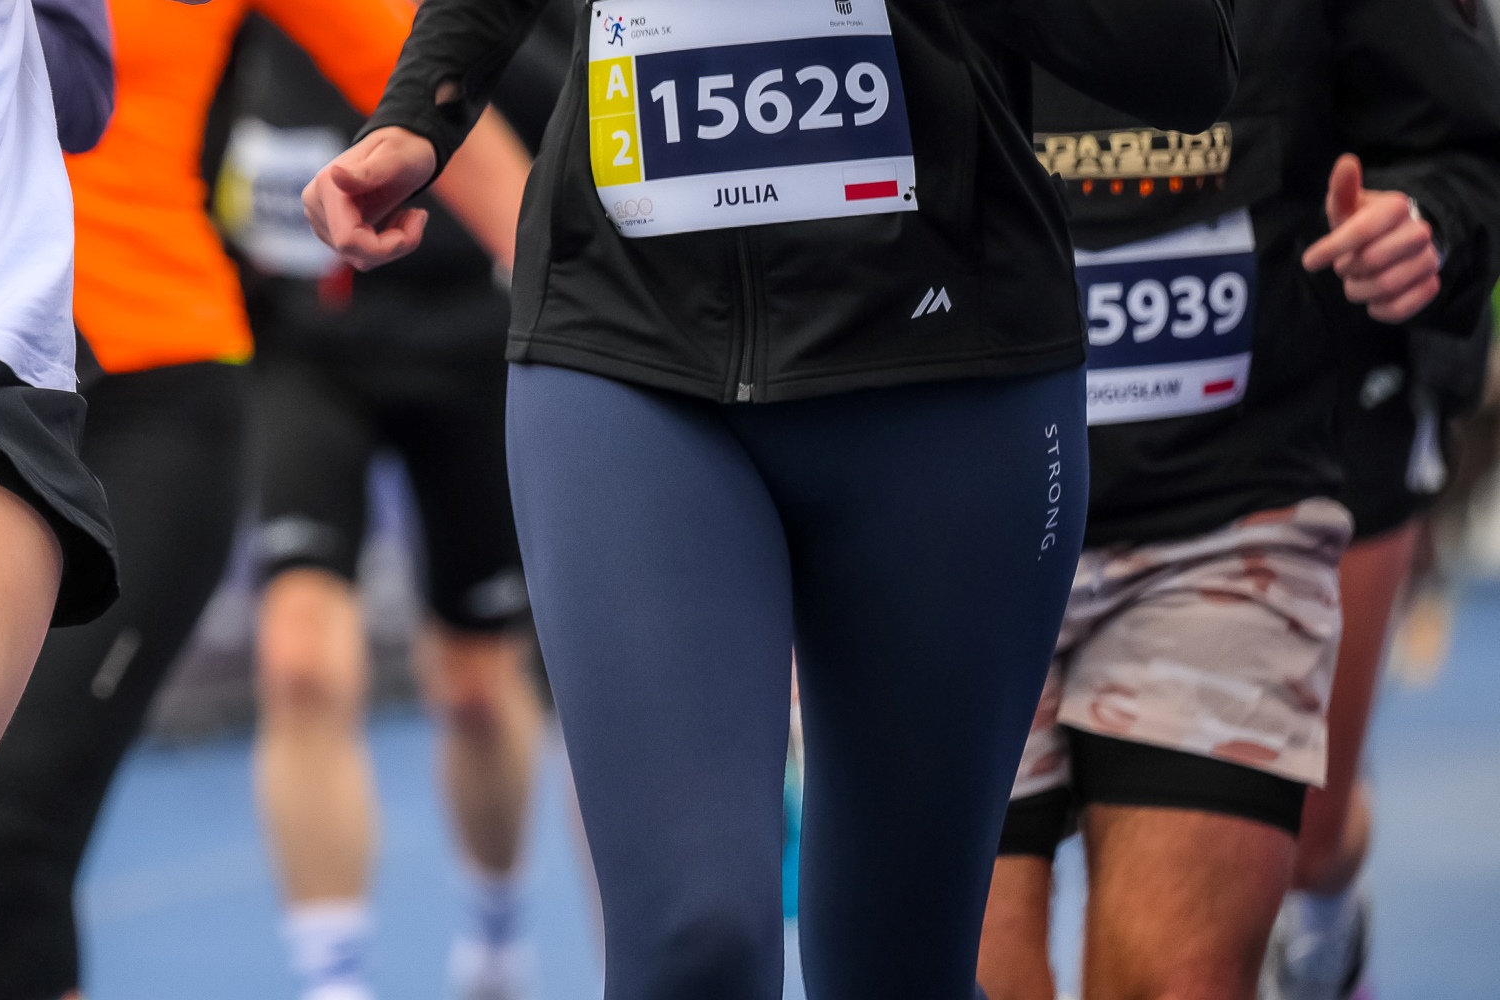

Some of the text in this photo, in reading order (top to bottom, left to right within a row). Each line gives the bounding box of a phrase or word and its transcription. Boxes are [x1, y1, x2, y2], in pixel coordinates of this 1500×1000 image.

[630, 17, 646, 27] PKO
[630, 27, 660, 40] GDYNIA
[606, 64, 629, 100] A
[649, 62, 889, 144] 15629
[611, 130, 633, 167] 2
[713, 183, 779, 208] JULIA
[1087, 271, 1249, 346] 5939
